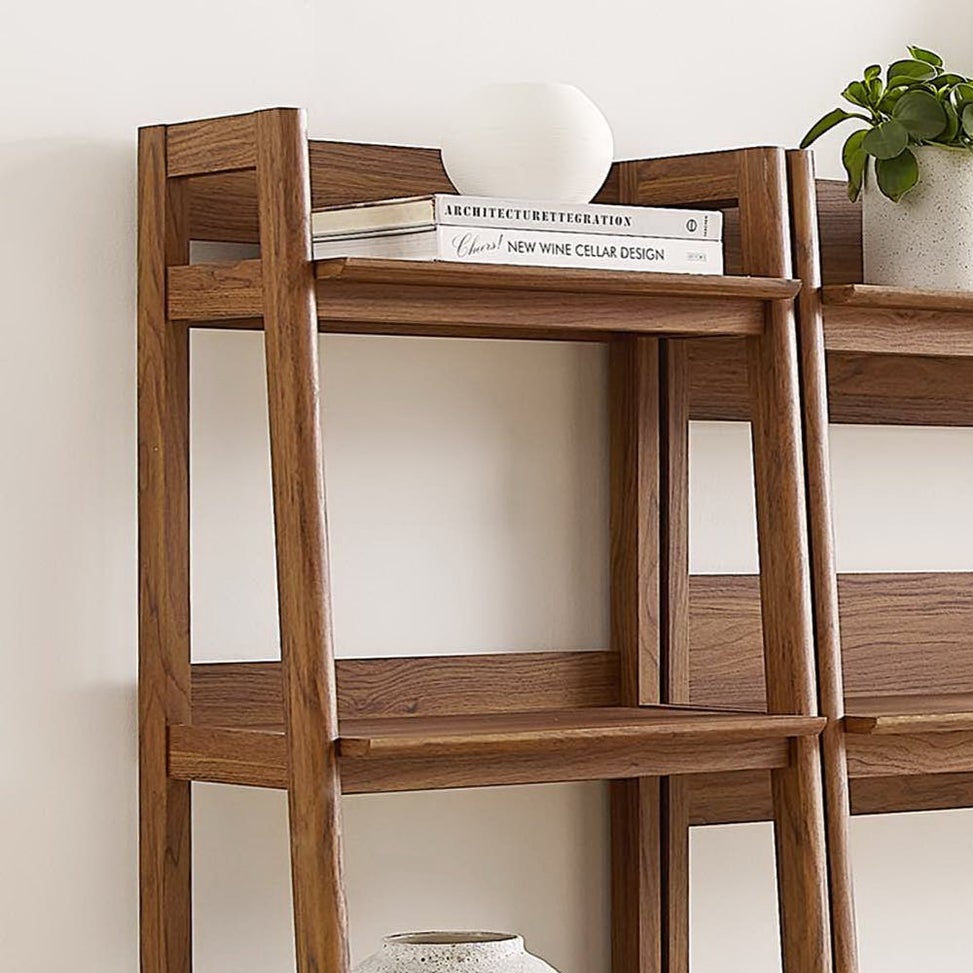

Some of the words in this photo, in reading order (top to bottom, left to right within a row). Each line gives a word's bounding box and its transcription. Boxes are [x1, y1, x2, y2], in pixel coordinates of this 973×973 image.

[451, 232, 504, 258] Cheers!
[507, 240, 537, 254] NEW
[538, 241, 572, 256] WINE
[574, 243, 618, 259] CELLAR
[620, 245, 666, 261] DESIGN
